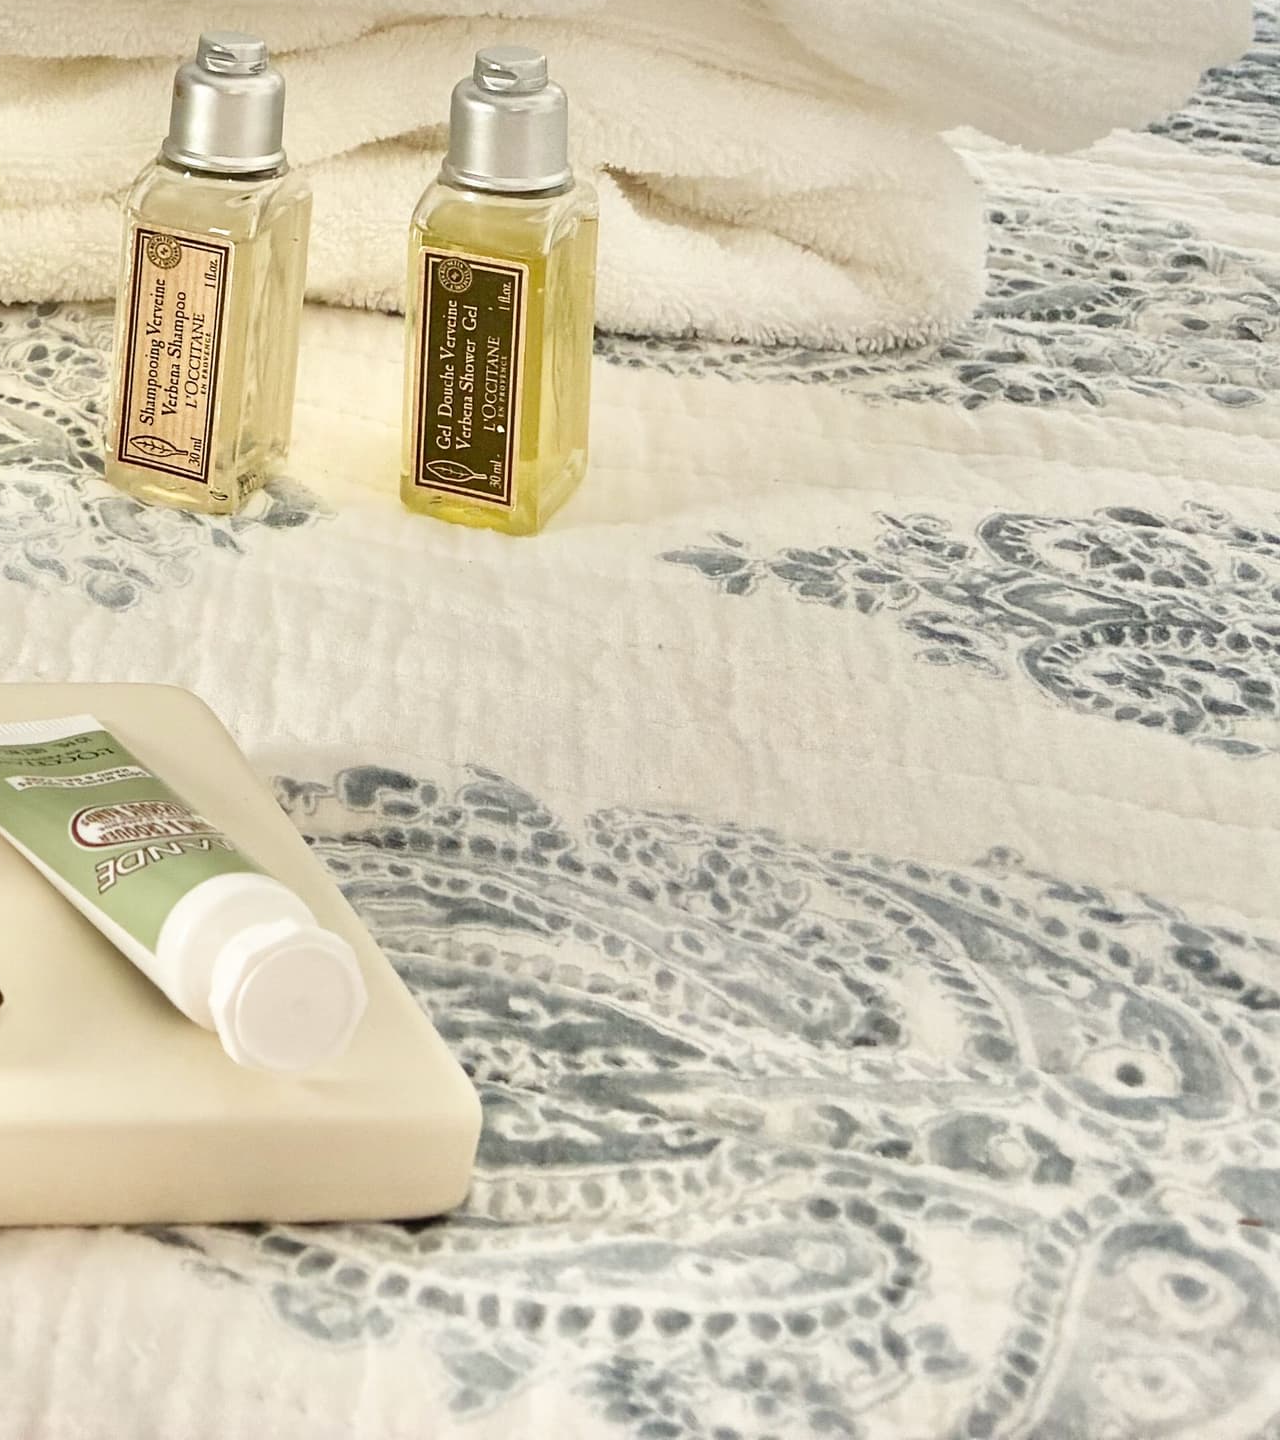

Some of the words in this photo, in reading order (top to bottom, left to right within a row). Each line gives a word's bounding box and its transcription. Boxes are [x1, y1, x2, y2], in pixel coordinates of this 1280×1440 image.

[146, 278, 166, 336] Verveine
[167, 291, 190, 360] Shampoo
[439, 299, 458, 361] Verveine
[462, 304, 479, 332] Gel
[140, 338, 165, 426] Shampooing
[184, 312, 206, 409] L'OCCITANE
[458, 337, 477, 393] Shower
[481, 335, 501, 433] L'OCCITANE
[161, 362, 181, 417] Verbena
[437, 364, 455, 418] Douche
[191, 437, 203, 452] ml
[436, 421, 453, 450] Gel
[455, 394, 473, 451] Verbena
[188, 451, 201, 467] 30
[490, 459, 502, 472] ml
